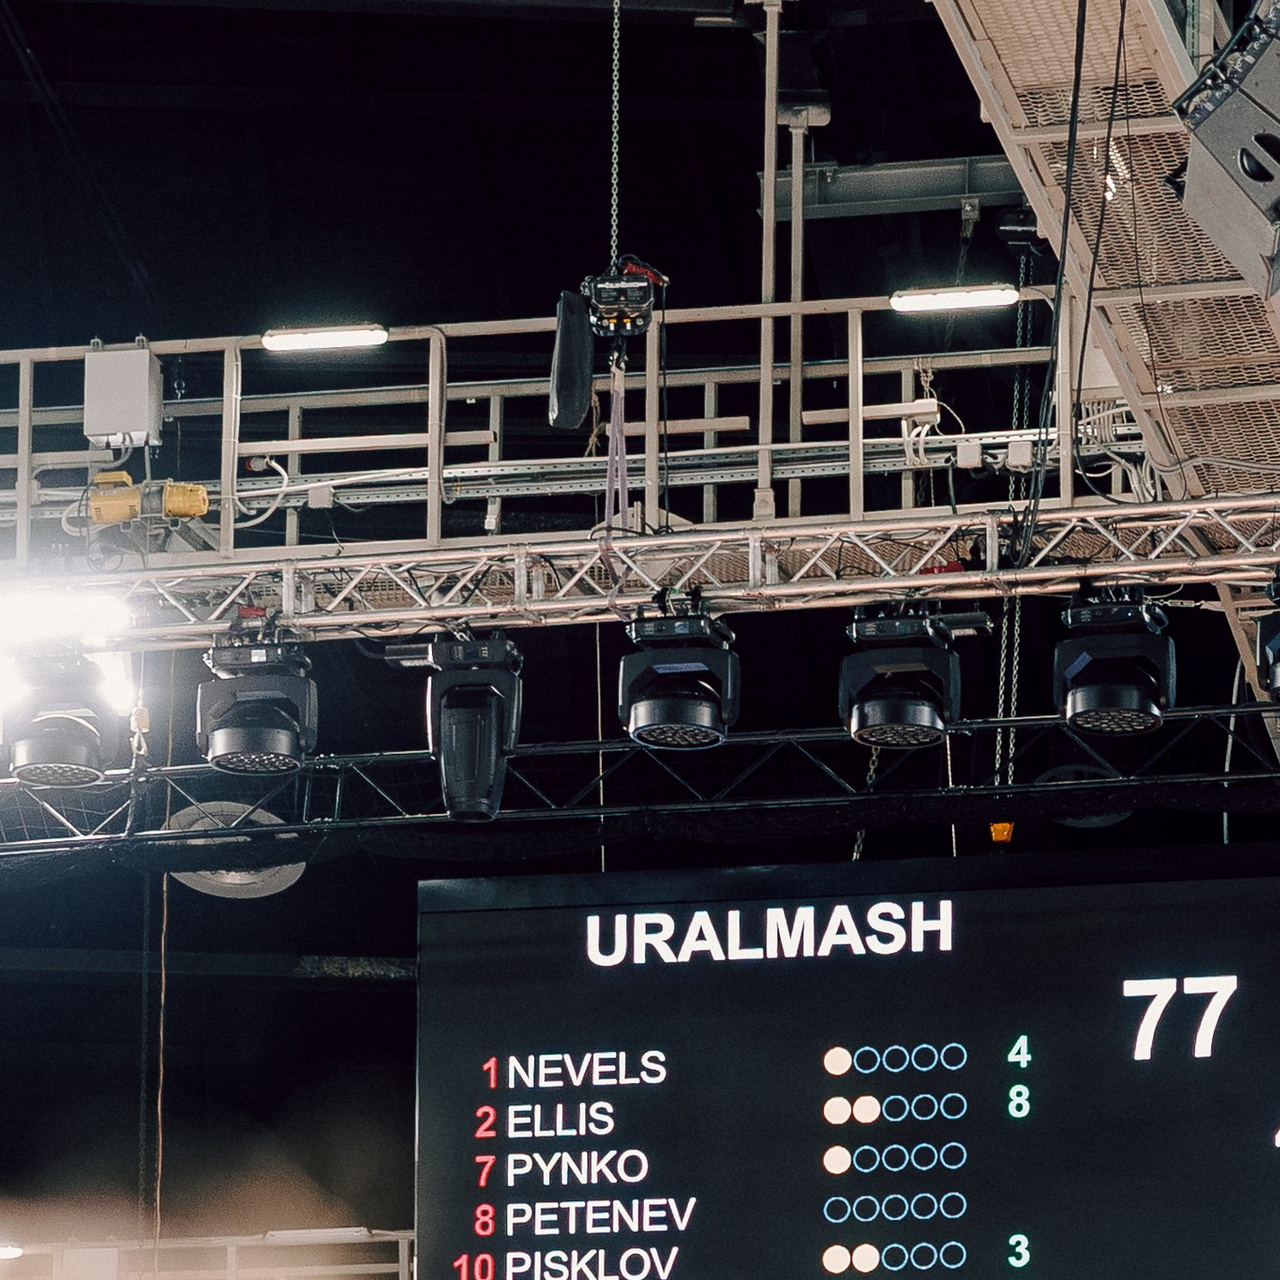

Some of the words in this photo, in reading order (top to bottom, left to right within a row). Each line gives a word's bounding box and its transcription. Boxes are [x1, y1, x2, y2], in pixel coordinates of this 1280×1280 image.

[586, 899, 953, 967] URALMASH
[1122, 974, 1238, 1061] 77
[482, 1056, 498, 1089] 1
[508, 1050, 667, 1089] NEVELS
[1007, 1034, 1032, 1069] 4
[474, 1105, 497, 1139] 2
[507, 1100, 615, 1139] ELLIS
[1007, 1084, 1031, 1119] 8
[474, 1154, 496, 1188] 7
[507, 1149, 649, 1187] PYNKO
[473, 1203, 496, 1237] 8
[506, 1196, 697, 1237] PETENEV
[1007, 1233, 1031, 1268] 3
